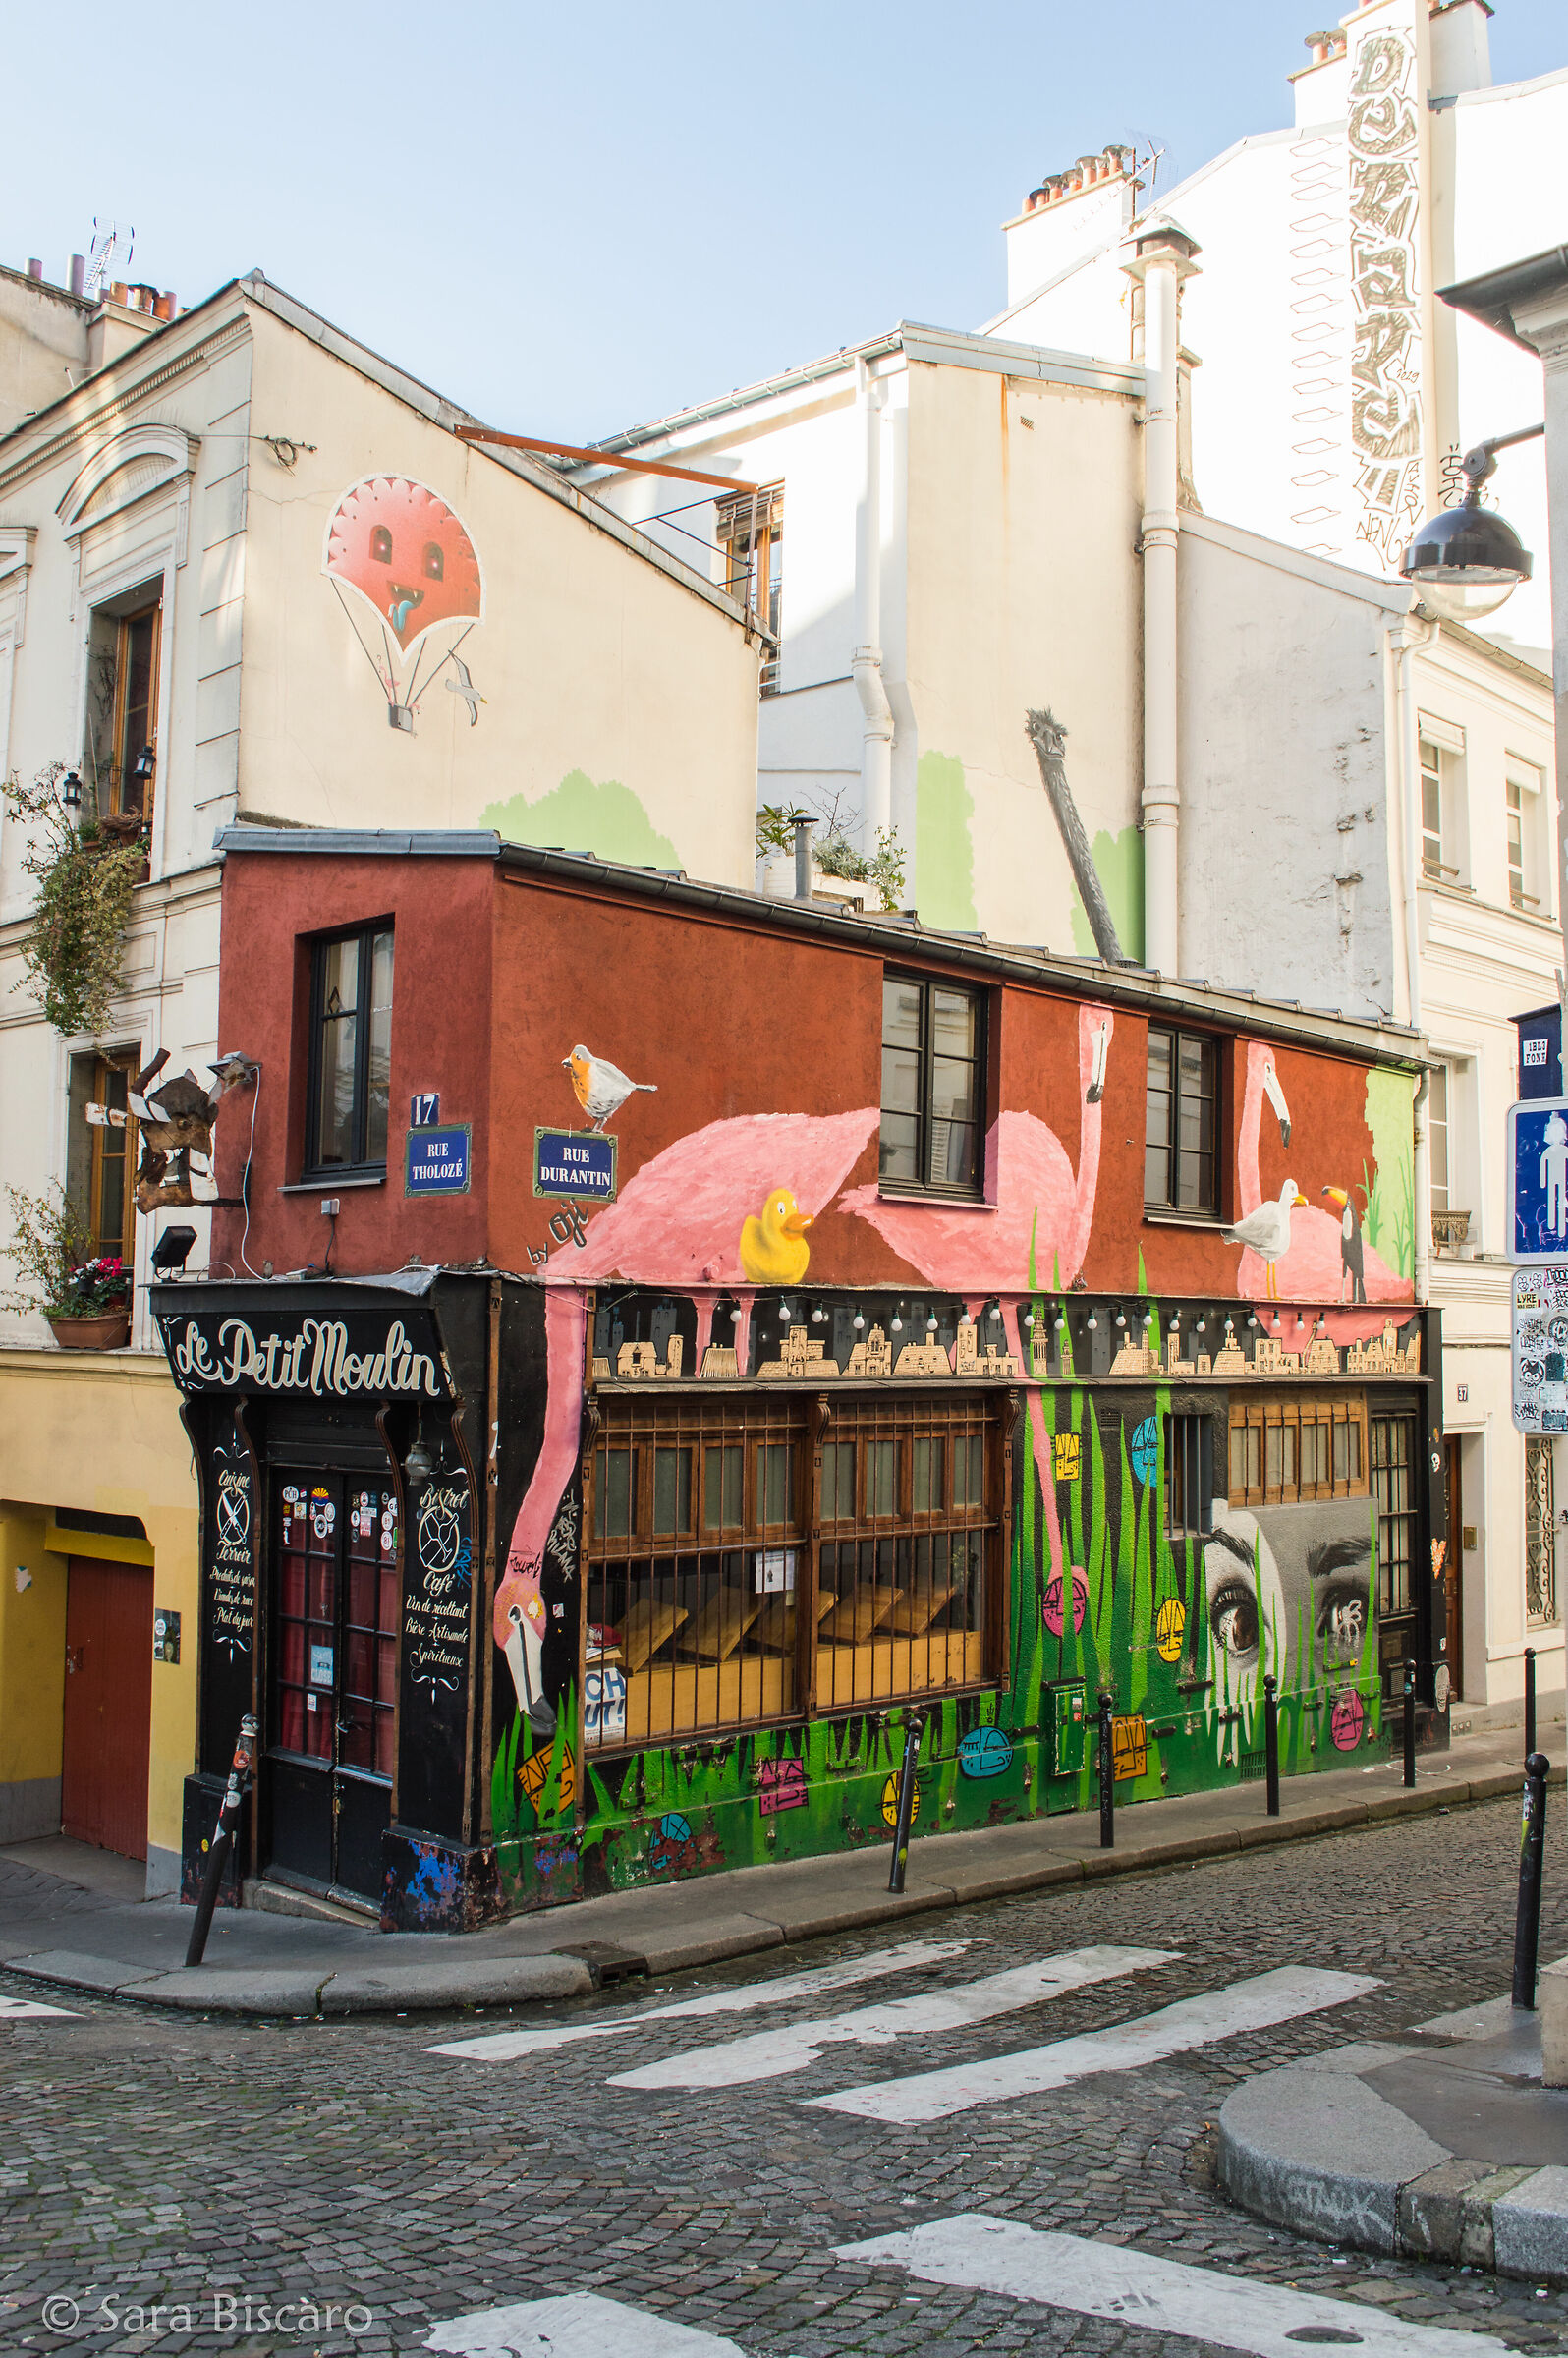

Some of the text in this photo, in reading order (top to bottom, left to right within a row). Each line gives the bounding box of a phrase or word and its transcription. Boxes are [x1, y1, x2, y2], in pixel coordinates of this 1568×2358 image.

[414, 1095, 436, 1126] 17
[426, 1142, 449, 1157] RUE
[563, 1147, 589, 1163] RUE
[412, 1158, 463, 1180] THOLOZÉ
[540, 1166, 611, 1186] DURANTIN
[527, 1197, 589, 1265] by Oji
[176, 1318, 440, 1396] Le Petit Moulin
[218, 1469, 250, 1497] Cuisine
[420, 1483, 470, 1520] Bistrot
[216, 1540, 252, 1564] Terroir
[423, 1571, 455, 1596] Café
[406, 1595, 421, 1611] Vin
[422, 1598, 431, 1612] de
[213, 1607, 253, 1632] Plat du jour
[409, 1643, 464, 1668] Spiritueux
